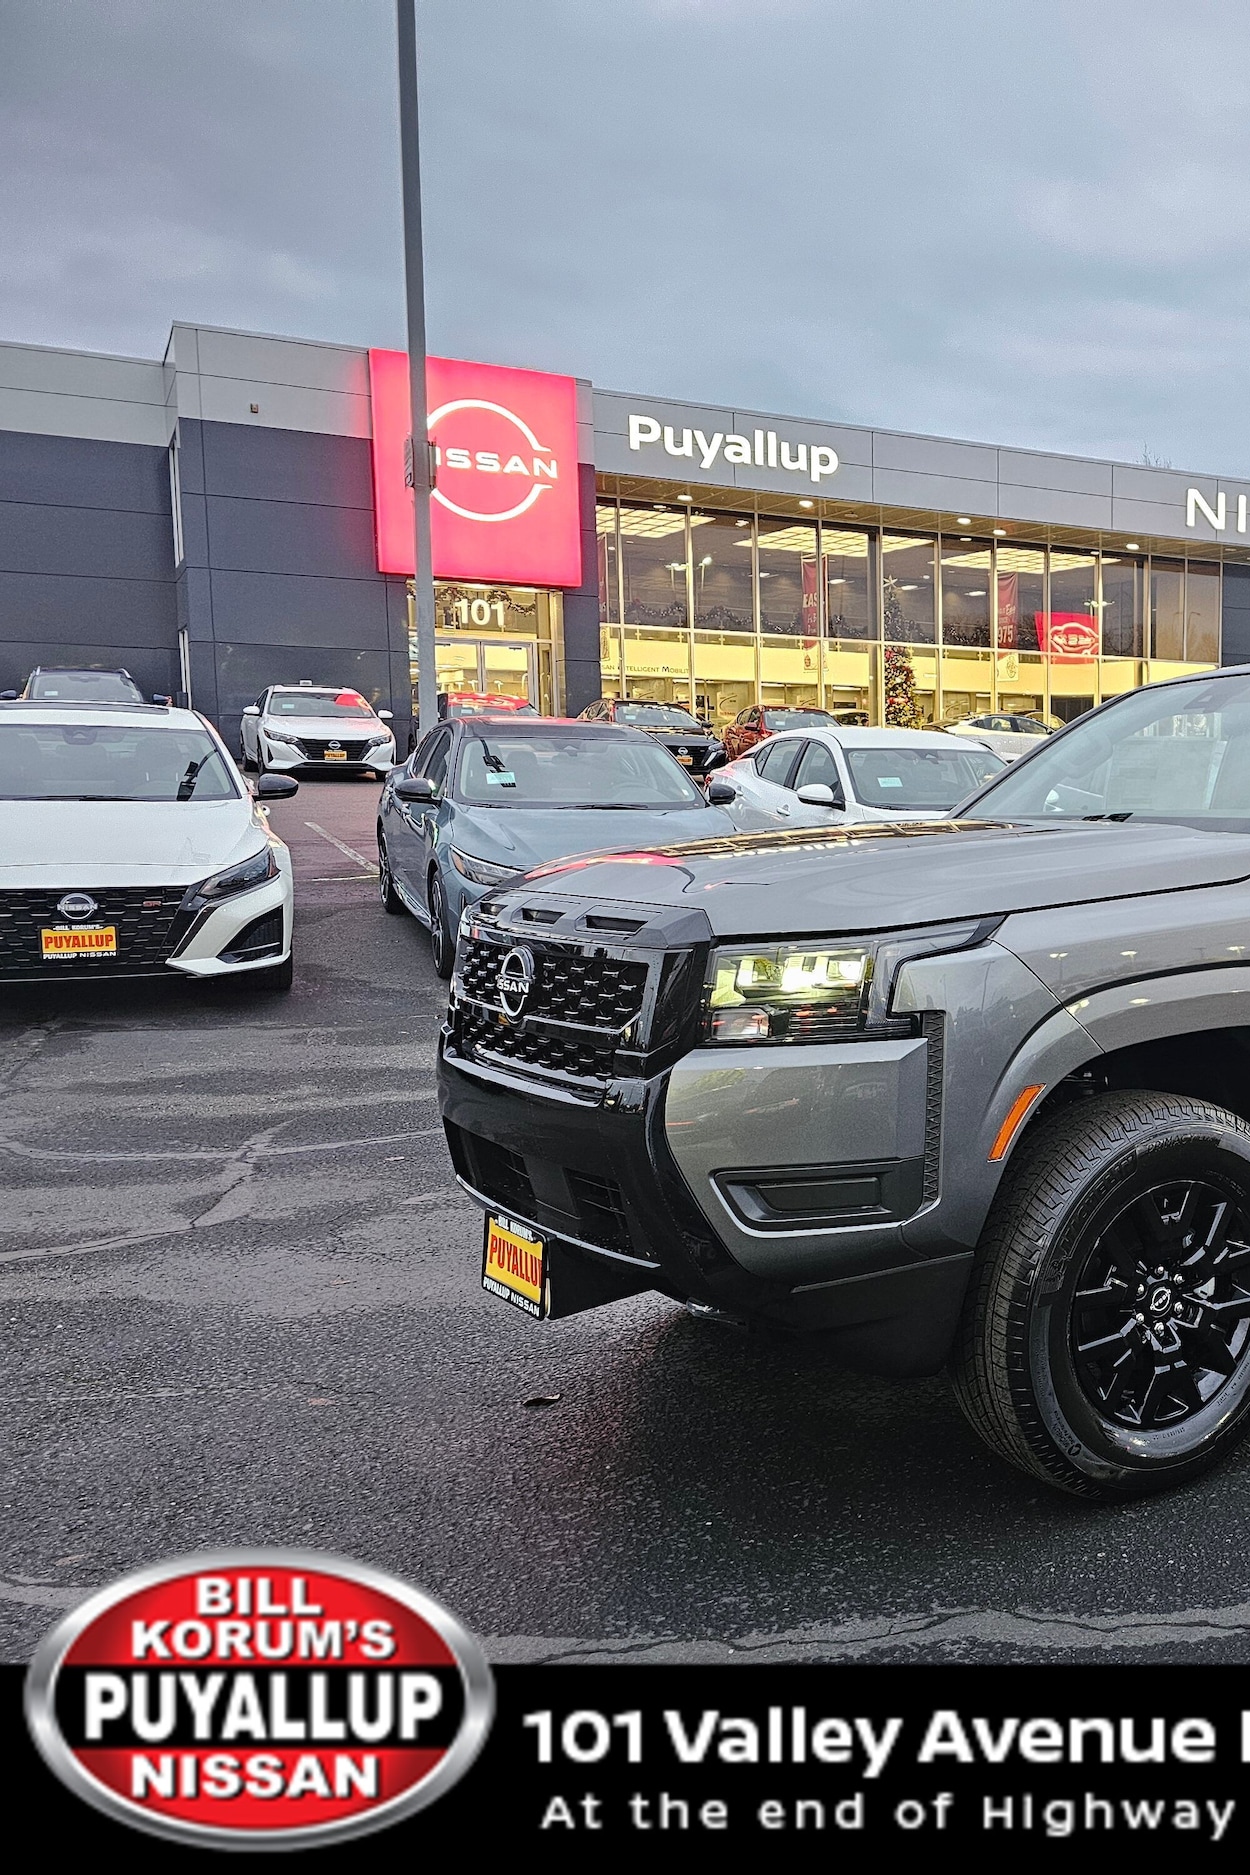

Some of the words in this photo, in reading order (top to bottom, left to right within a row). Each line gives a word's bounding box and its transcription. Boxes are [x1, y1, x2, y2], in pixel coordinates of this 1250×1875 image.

[628, 414, 839, 482] Puyallup
[436, 446, 558, 479] ISSAN
[454, 598, 504, 627] 101
[57, 903, 98, 911] NISSAN
[44, 934, 114, 949] PUYALLUP
[511, 1292, 540, 1317] NISSAN
